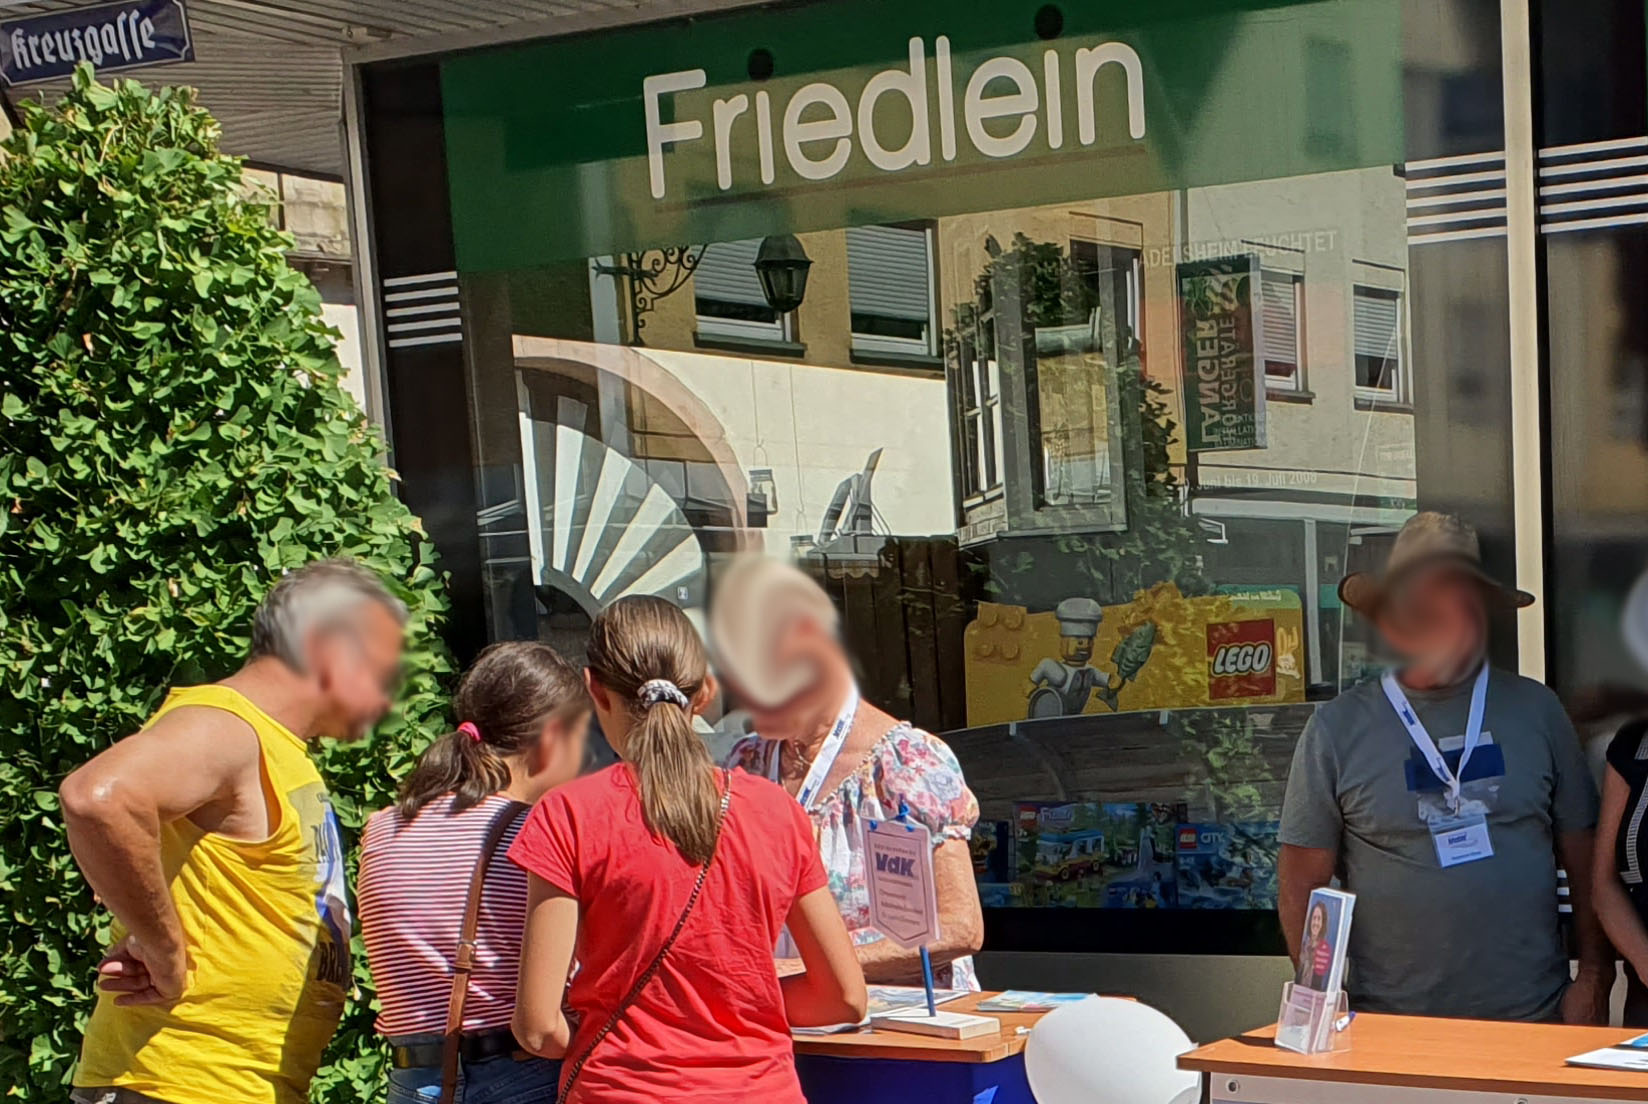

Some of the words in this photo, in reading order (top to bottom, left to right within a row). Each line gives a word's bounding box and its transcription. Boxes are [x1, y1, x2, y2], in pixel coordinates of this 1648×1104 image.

[643, 35, 1146, 198] Friedlein
[1213, 643, 1271, 676] LEGO
[875, 852, 916, 878] VdK
